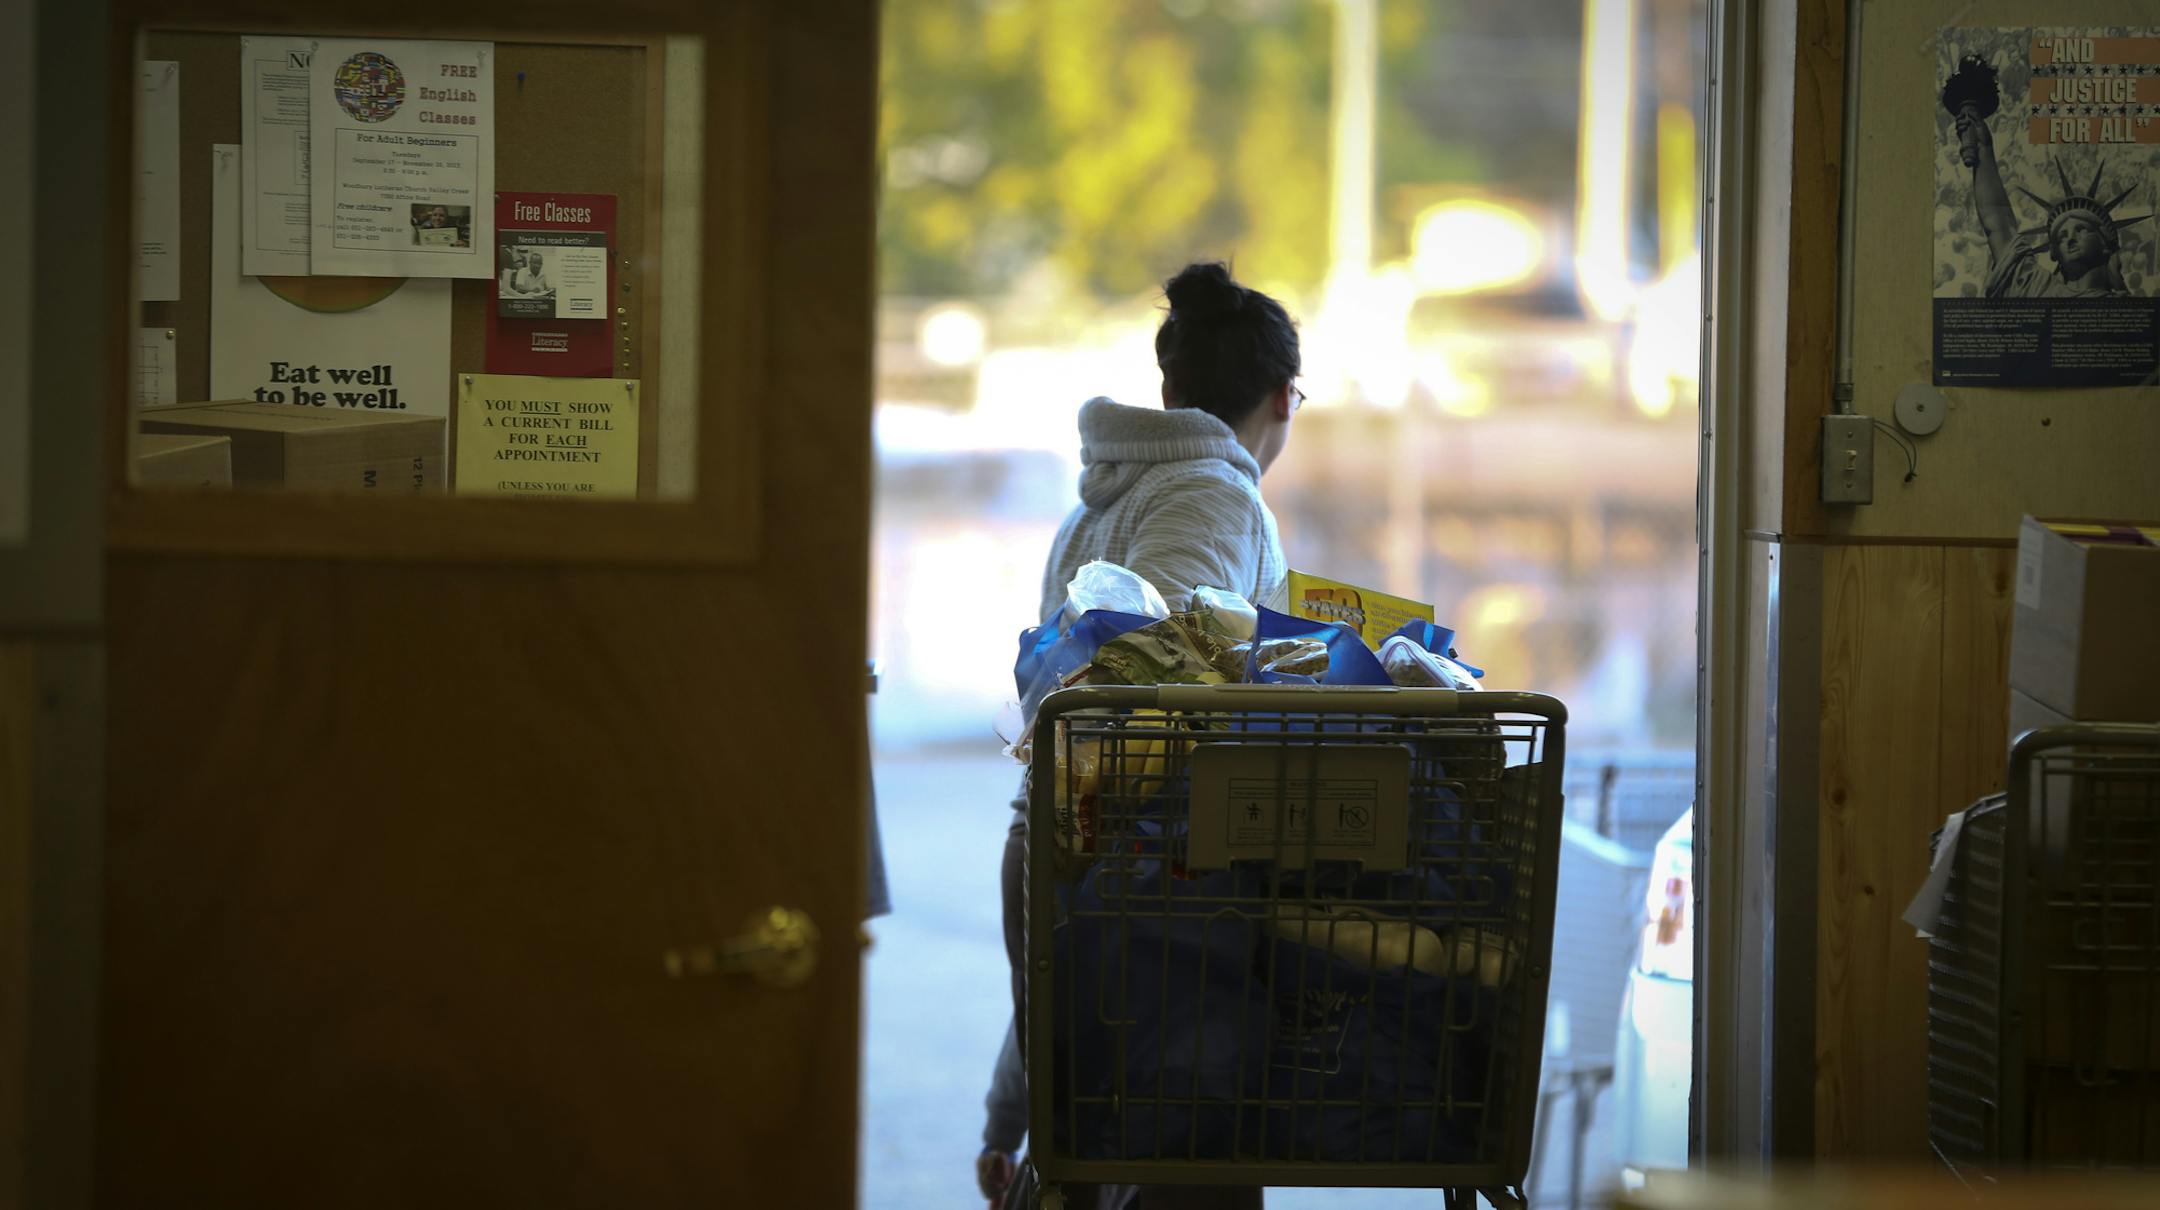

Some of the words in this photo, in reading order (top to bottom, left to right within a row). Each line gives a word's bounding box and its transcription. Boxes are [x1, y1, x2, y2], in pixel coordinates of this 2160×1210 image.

[441, 65, 478, 78] FREE
[420, 87, 478, 103] English
[2049, 78, 2137, 104] JUSTICE
[419, 111, 477, 125] Classes
[2050, 118, 2091, 144] FOR
[357, 133, 375, 142] For
[376, 135, 404, 144] Adult
[407, 136, 458, 148] Beginners
[352, 156, 386, 164] September
[514, 201, 541, 221] Free
[544, 202, 592, 224] Classes
[518, 236, 536, 244] Need
[538, 236, 546, 244] to
[564, 236, 590, 246] better?
[531, 336, 568, 348] Literacy
[270, 362, 320, 384] Eat
[328, 365, 392, 386] well
[254, 387, 286, 404] to
[292, 386, 326, 406] be
[334, 388, 406, 409] well.
[485, 399, 516, 412] YOU
[520, 400, 562, 414] MUST
[568, 402, 613, 414] SHOW
[483, 417, 494, 428] A
[501, 417, 572, 430] CURRENT
[579, 419, 614, 431] BILL
[509, 433, 539, 445] FOR
[545, 434, 588, 447] EACH
[494, 450, 602, 463] APPOINTMENT
[497, 480, 544, 492] (UNLESS
[546, 482, 570, 493] YOU
[572, 483, 596, 494] ARE
